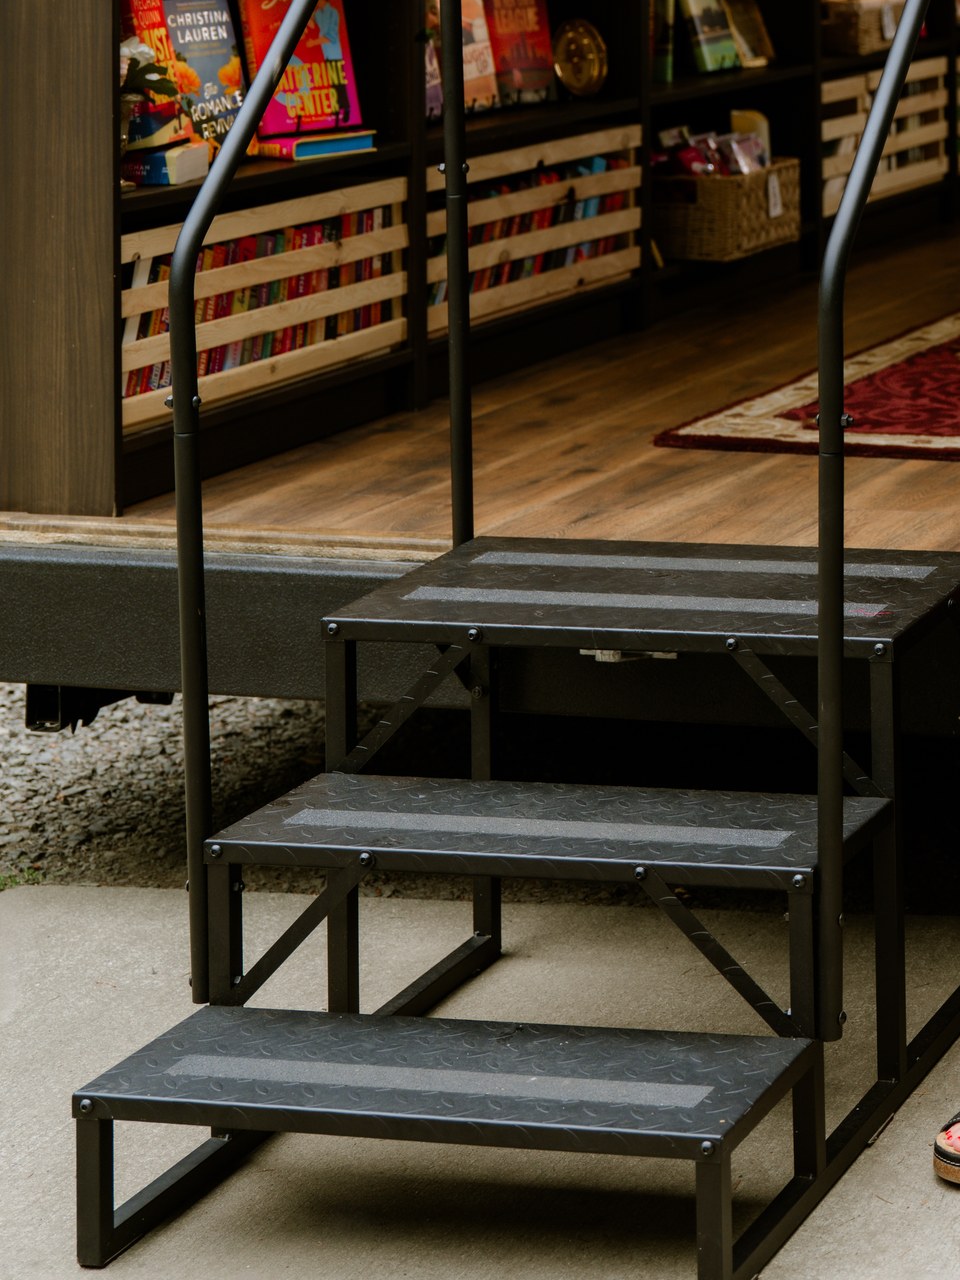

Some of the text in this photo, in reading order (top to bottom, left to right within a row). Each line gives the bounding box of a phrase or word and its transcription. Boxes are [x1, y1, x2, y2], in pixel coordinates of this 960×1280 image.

[138, 10, 162, 29] QUINN
[167, 10, 230, 28] CHRISTINA
[176, 25, 228, 44] LAUREN
[279, 60, 349, 92] ATHERINE
[190, 89, 243, 123] ROMANCE
[286, 88, 340, 118] CENTER
